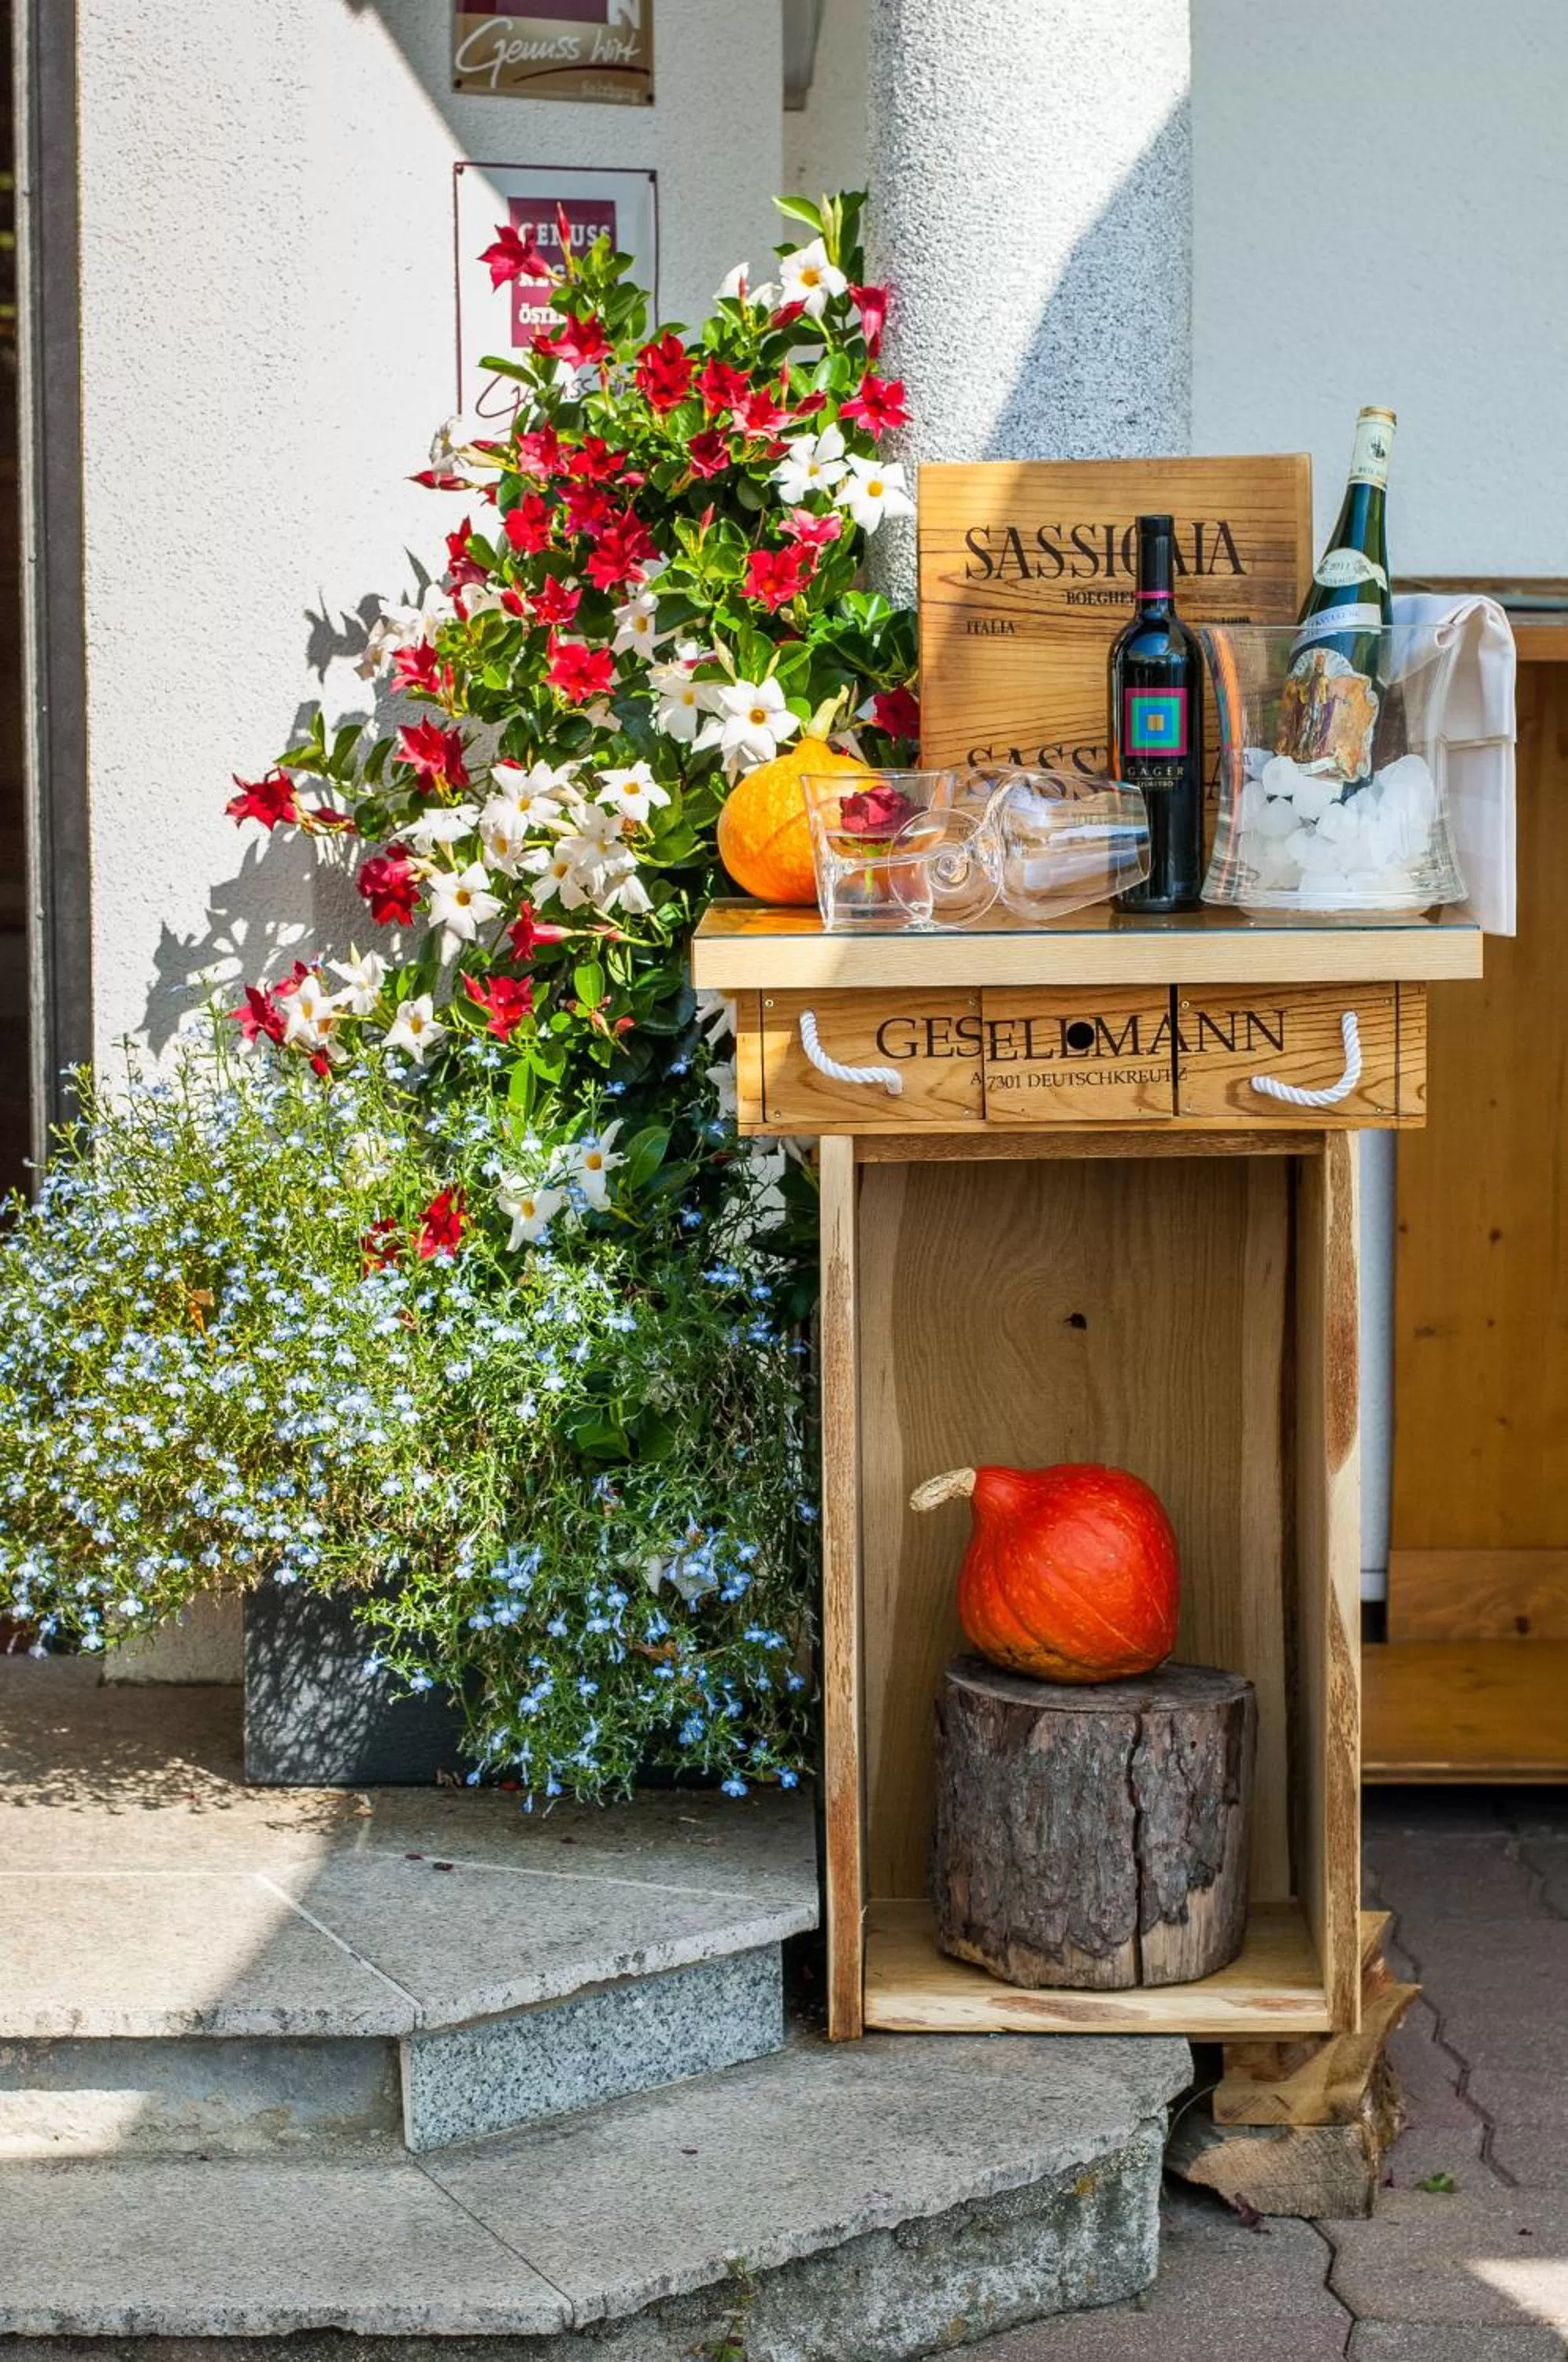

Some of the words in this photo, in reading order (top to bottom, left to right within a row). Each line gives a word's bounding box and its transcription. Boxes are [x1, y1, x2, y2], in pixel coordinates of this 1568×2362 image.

[965, 520, 1247, 580] SASSIIA
[967, 620, 1015, 635] ITALIA
[1127, 766, 1184, 776] GAGER
[876, 1010, 1288, 1062] GESELLMANN
